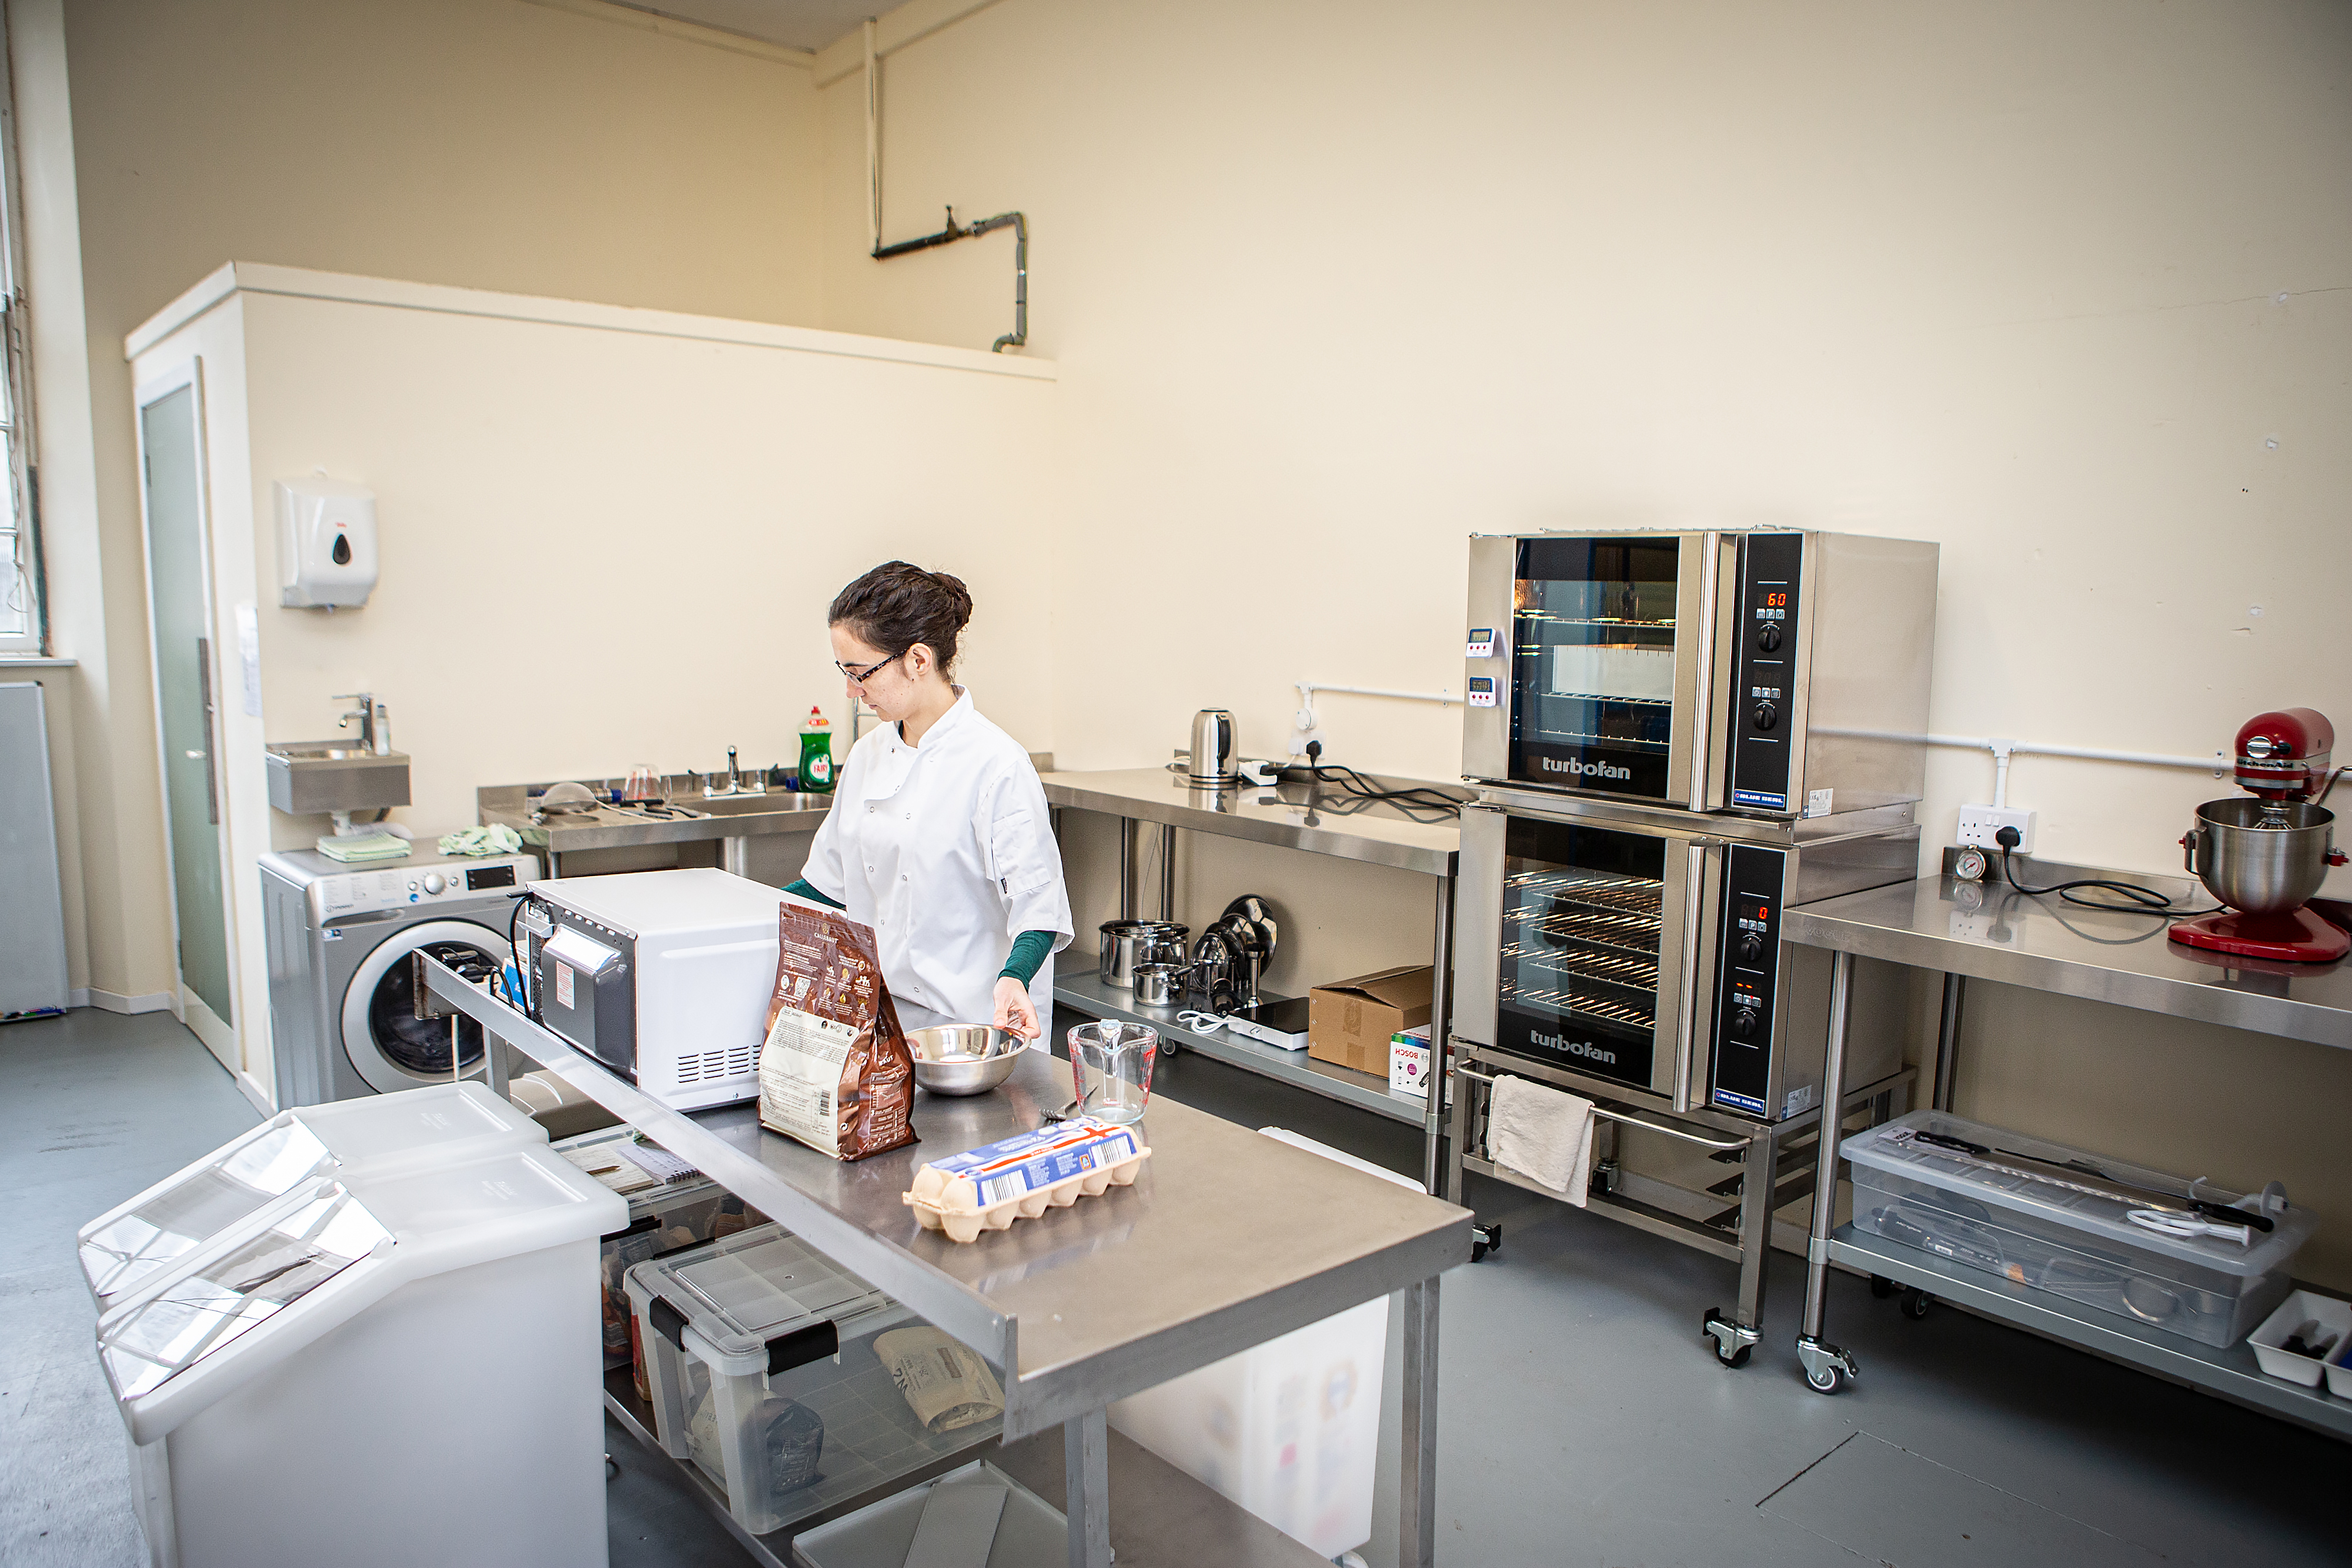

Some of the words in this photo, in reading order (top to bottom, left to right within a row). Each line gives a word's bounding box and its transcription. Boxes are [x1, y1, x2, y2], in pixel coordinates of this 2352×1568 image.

[1768, 593, 1786, 606] 60
[814, 764, 828, 773] FAIRY
[1542, 757, 1631, 780] turbofan
[1758, 906, 1768, 920] 0
[814, 932, 839, 944] CALLEBAUT
[1530, 1029, 1616, 1064] turbofan
[1395, 1048, 1419, 1059] BOSCH
[1720, 1094, 1741, 1102] BLUE
[1742, 1099, 1762, 1108] SEAL
